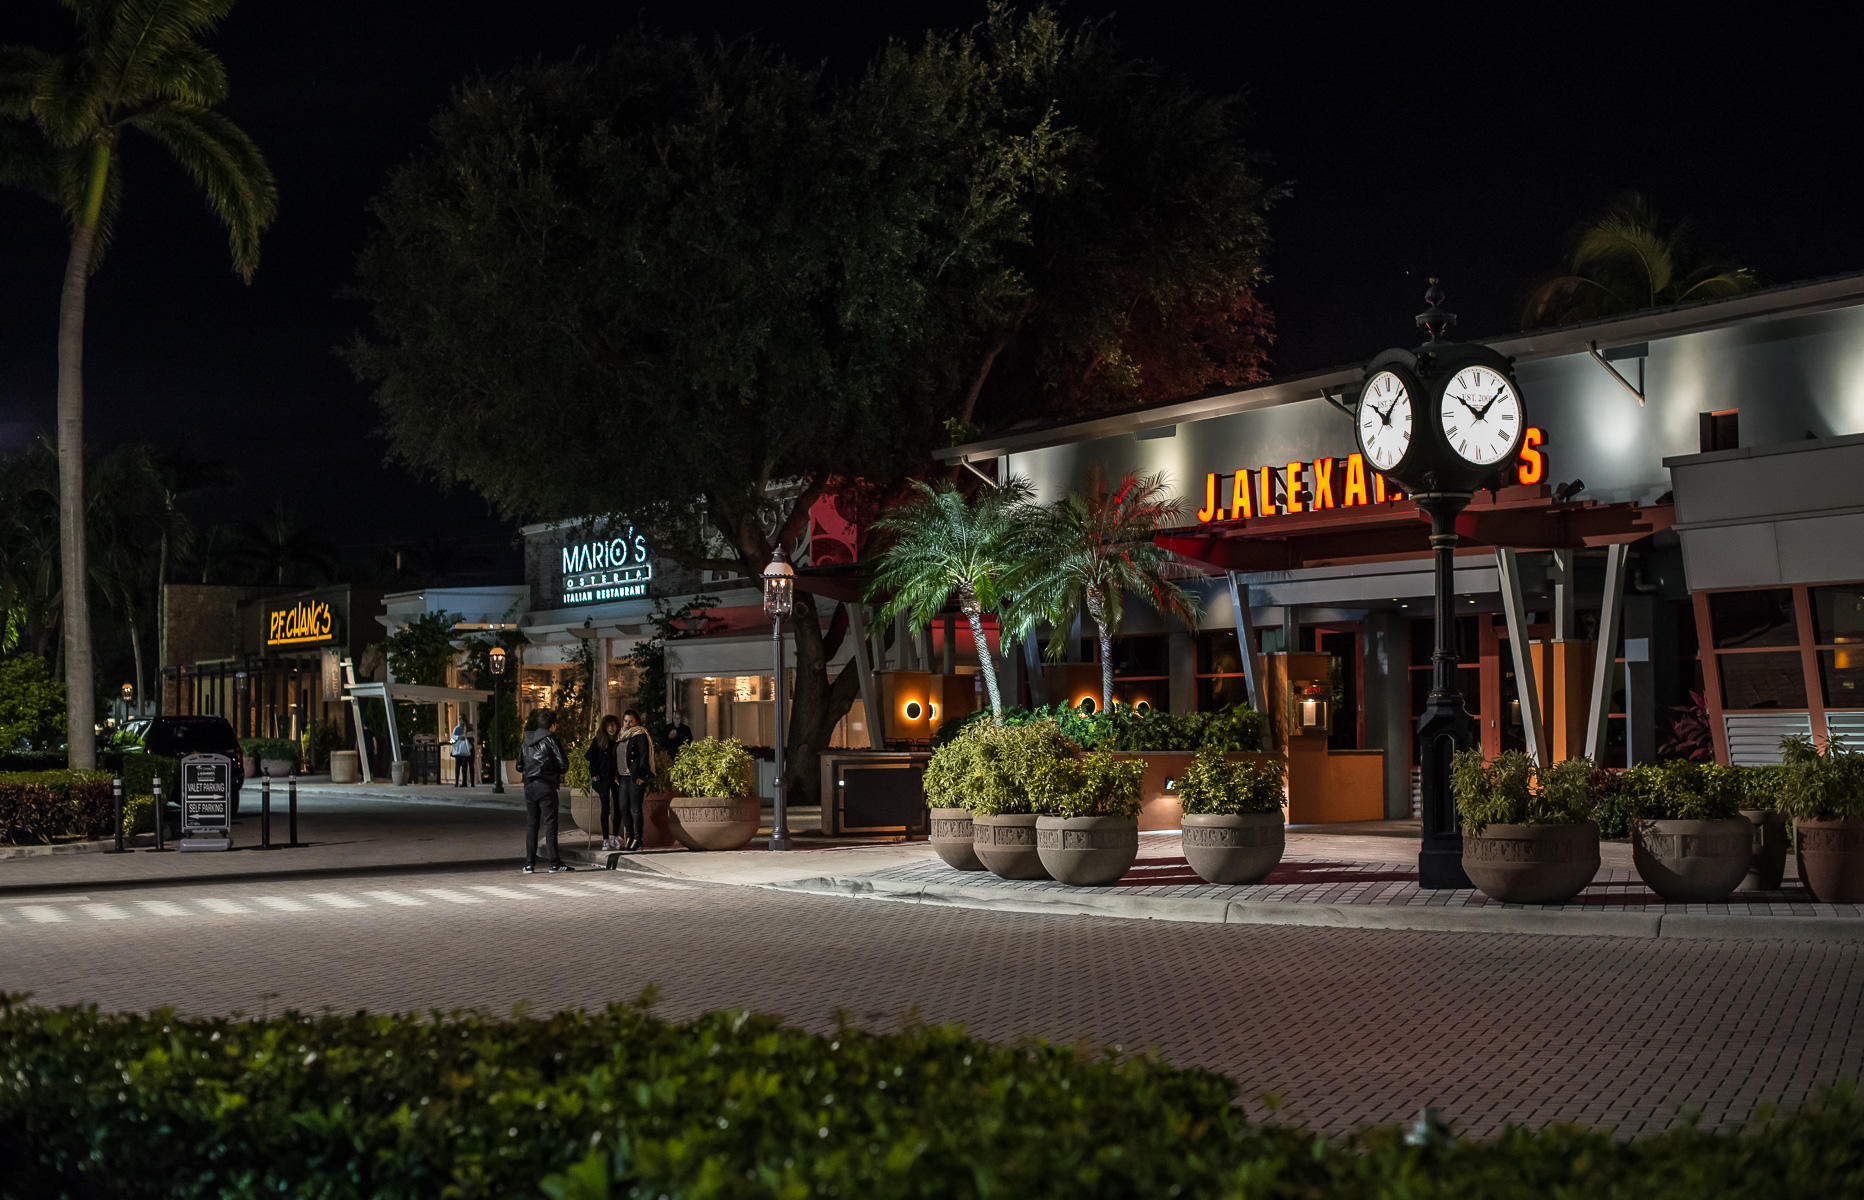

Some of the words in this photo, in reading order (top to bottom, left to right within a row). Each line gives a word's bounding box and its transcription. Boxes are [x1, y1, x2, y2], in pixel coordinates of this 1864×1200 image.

[562, 526, 647, 574] MARIO'S
[566, 569, 642, 588] OSTERIA
[563, 591, 593, 604] ITALIAN
[596, 585, 645, 600] RESTAURANT
[286, 600, 331, 638] CHANG'S
[187, 783, 203, 793] VALET
[203, 783, 225, 793] PARKING
[188, 803, 201, 813] SELF
[201, 803, 224, 813] PARKING
